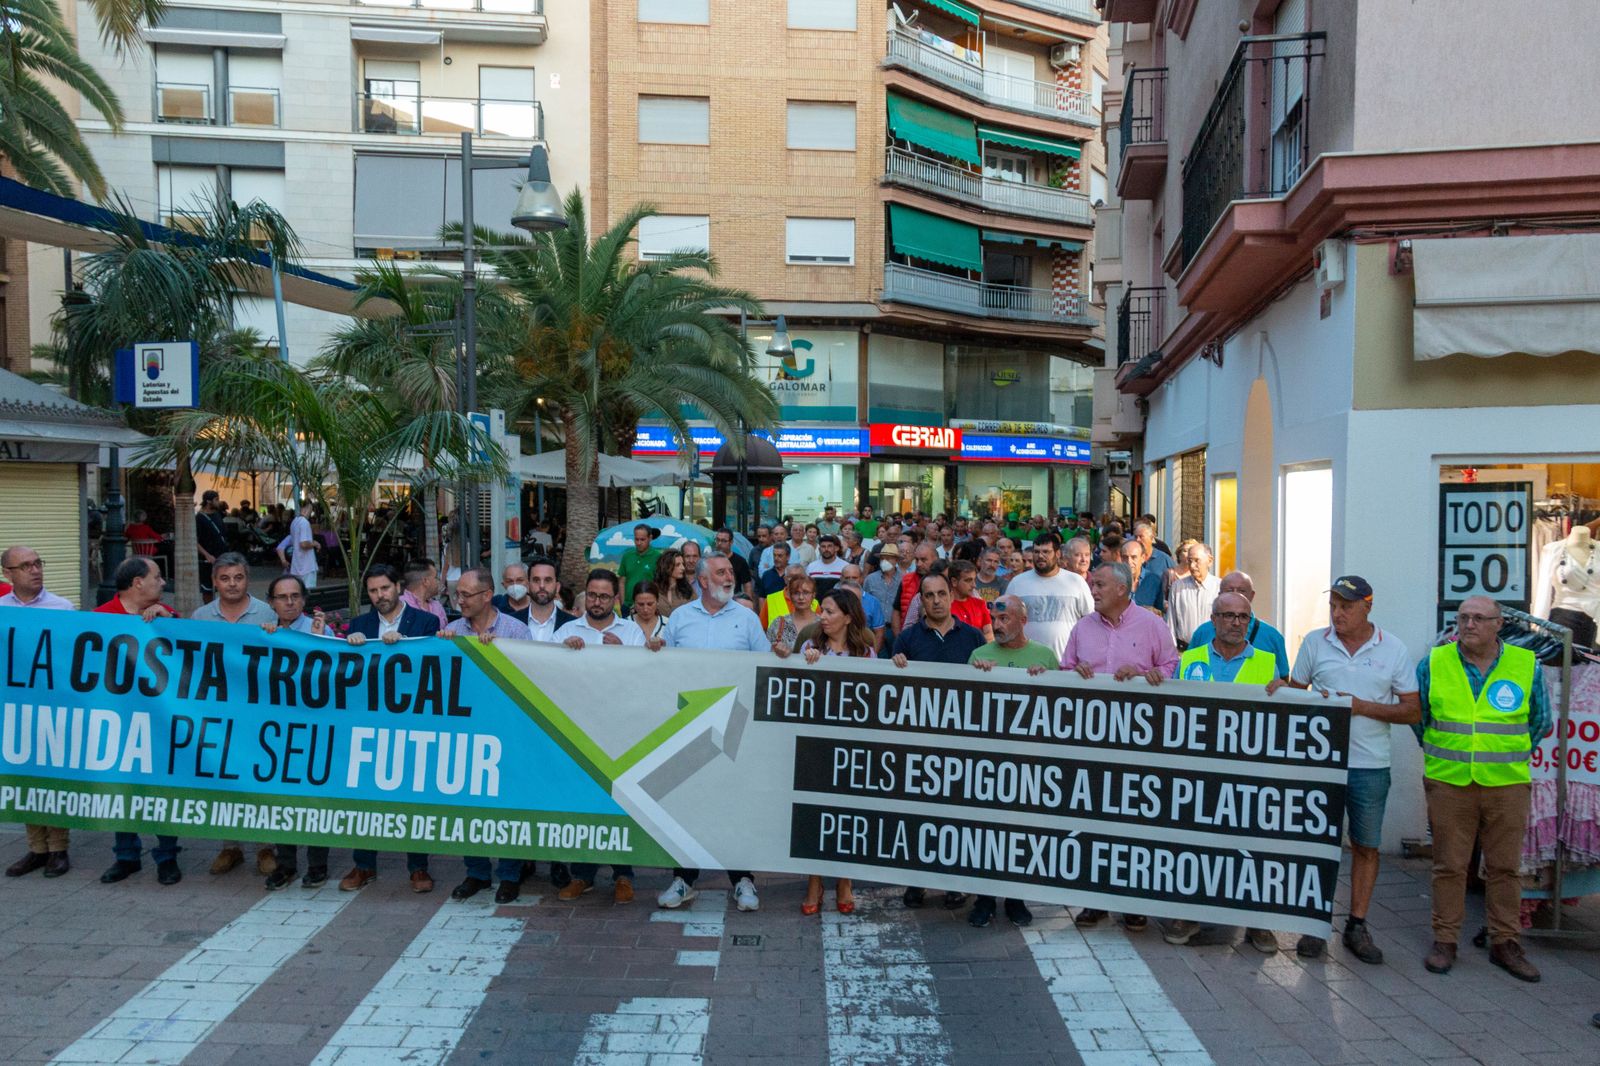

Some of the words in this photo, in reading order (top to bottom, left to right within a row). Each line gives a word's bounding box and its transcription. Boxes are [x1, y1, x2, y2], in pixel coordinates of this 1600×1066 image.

[769, 381, 826, 392] GALOMAR
[1448, 500, 1524, 533] TODO
[7, 626, 54, 690] LA
[70, 631, 228, 702] COSTA
[242, 644, 472, 717] TROPICAL
[2, 702, 153, 774] UNIDA
[168, 714, 240, 780] PEL
[252, 720, 335, 786] SEU
[346, 726, 502, 797] FUTUR
[766, 676, 816, 720] PER
[824, 680, 870, 723] LES
[877, 684, 1154, 746] CANALITZACIONS
[1162, 704, 1208, 751] DE
[1216, 708, 1341, 762] RULES.
[0, 785, 125, 819] PLATAFORMA
[129, 795, 168, 823] PER
[170, 798, 207, 825] LES
[210, 801, 407, 839] INFRAESTRUCTURES
[411, 814, 437, 841] DE
[439, 816, 465, 842] LA
[469, 818, 531, 847] COSTA
[537, 822, 633, 852] TROPICAL
[832, 747, 896, 792] PELS
[904, 753, 1063, 808] ESPIGONS
[1069, 768, 1093, 812] A
[1101, 770, 1162, 819] LES
[1170, 777, 1338, 838] PLATGES.
[819, 812, 869, 857] PER
[877, 818, 910, 861] LA
[918, 822, 1081, 881] CONNEXIÓ
[1090, 840, 1333, 913] FERROVIÀRIA.
